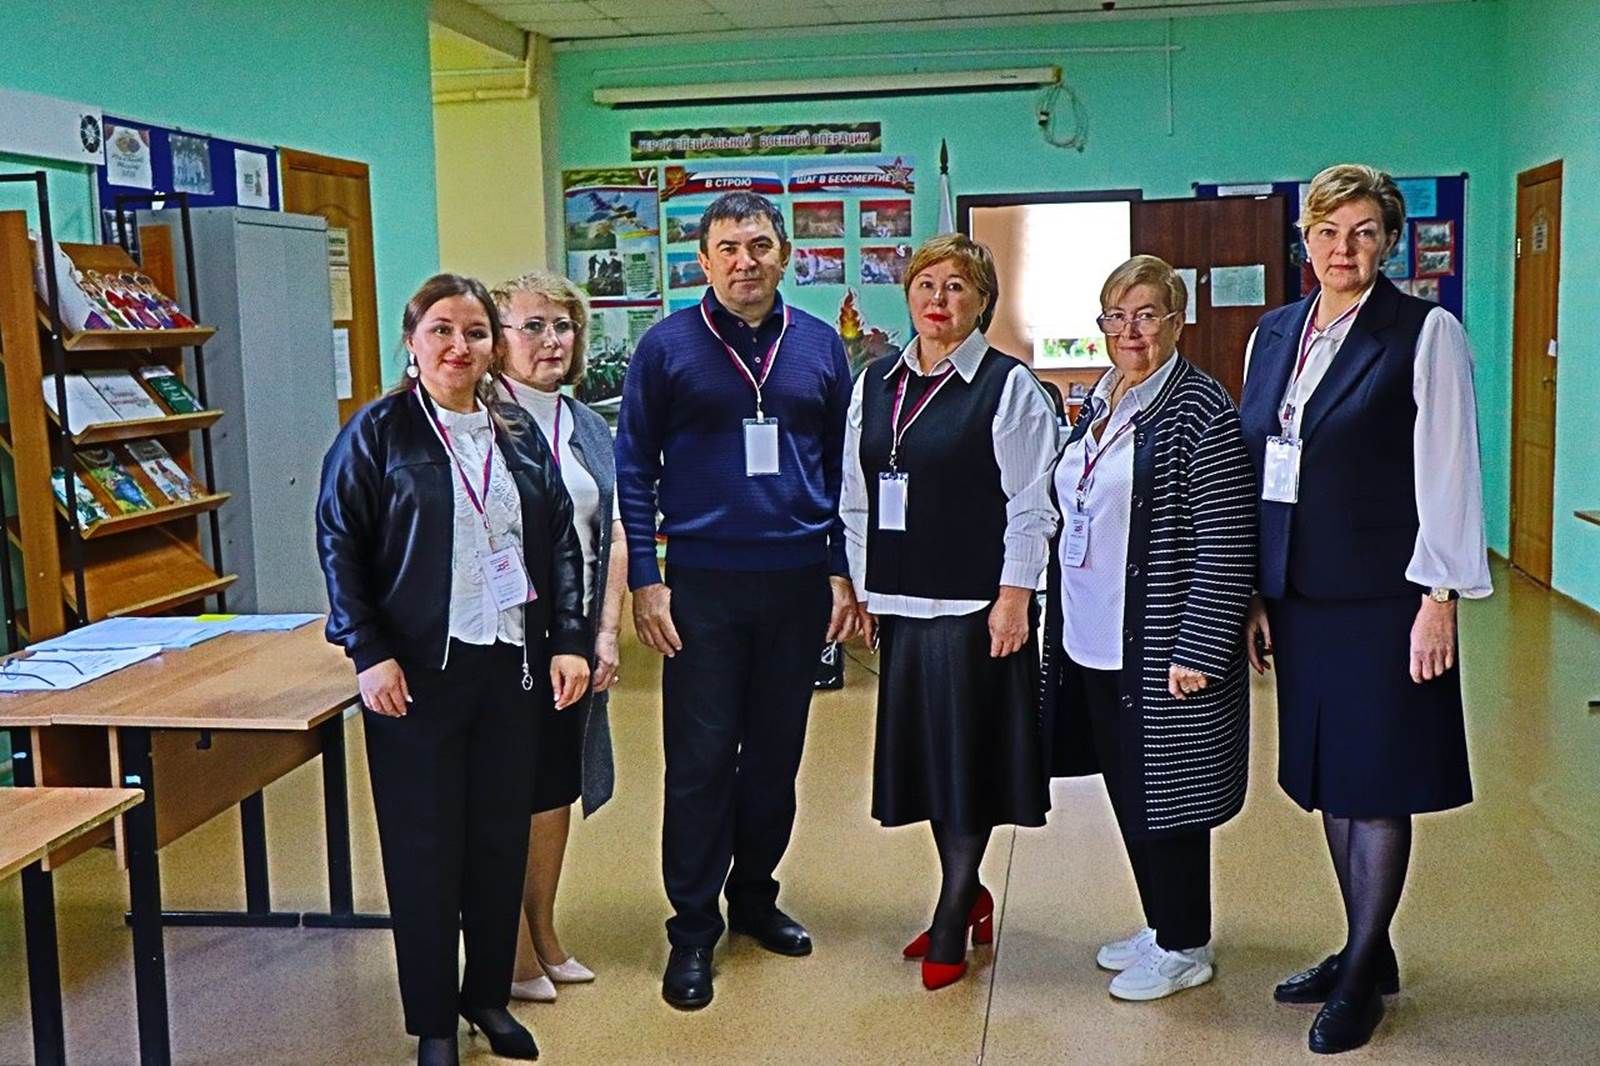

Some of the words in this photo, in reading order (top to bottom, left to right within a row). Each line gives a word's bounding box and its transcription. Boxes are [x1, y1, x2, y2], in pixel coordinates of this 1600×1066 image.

[760, 129, 811, 147] ВОЕННОЙ
[812, 131, 870, 146] ОПЕРАЦИИ
[705, 179, 713, 188] В
[715, 178, 752, 187] СТРОЮ
[796, 176, 817, 184] ШАГ
[819, 175, 827, 184] В
[828, 173, 892, 183] БЕССМЕРТИЕ
